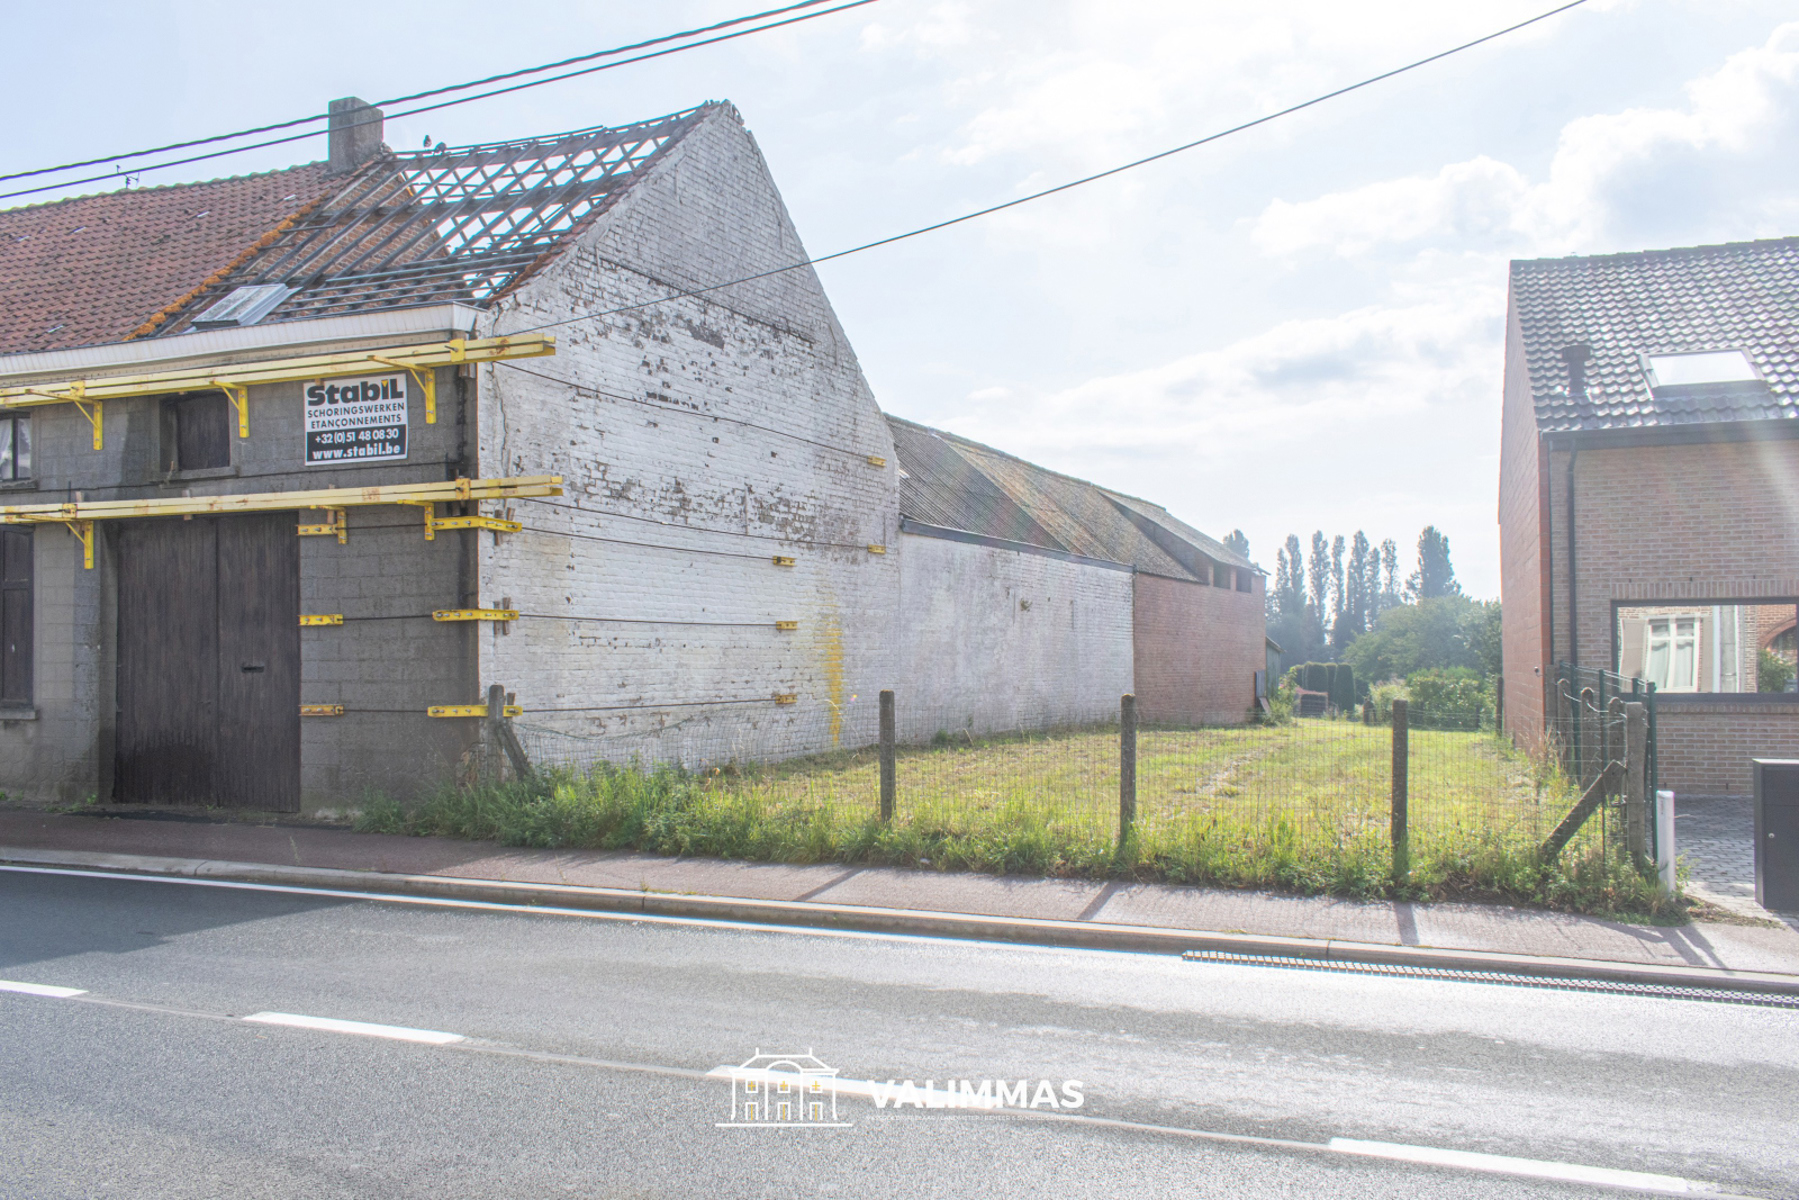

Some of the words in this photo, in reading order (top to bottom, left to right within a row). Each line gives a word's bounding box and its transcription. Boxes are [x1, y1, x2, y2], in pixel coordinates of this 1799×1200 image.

[307, 402, 405, 418] SCHORINGSWERKEN
[311, 414, 402, 429] ETANÇONNEMENTS
[315, 433, 333, 444] +32
[312, 442, 401, 460] www.stabil.be
